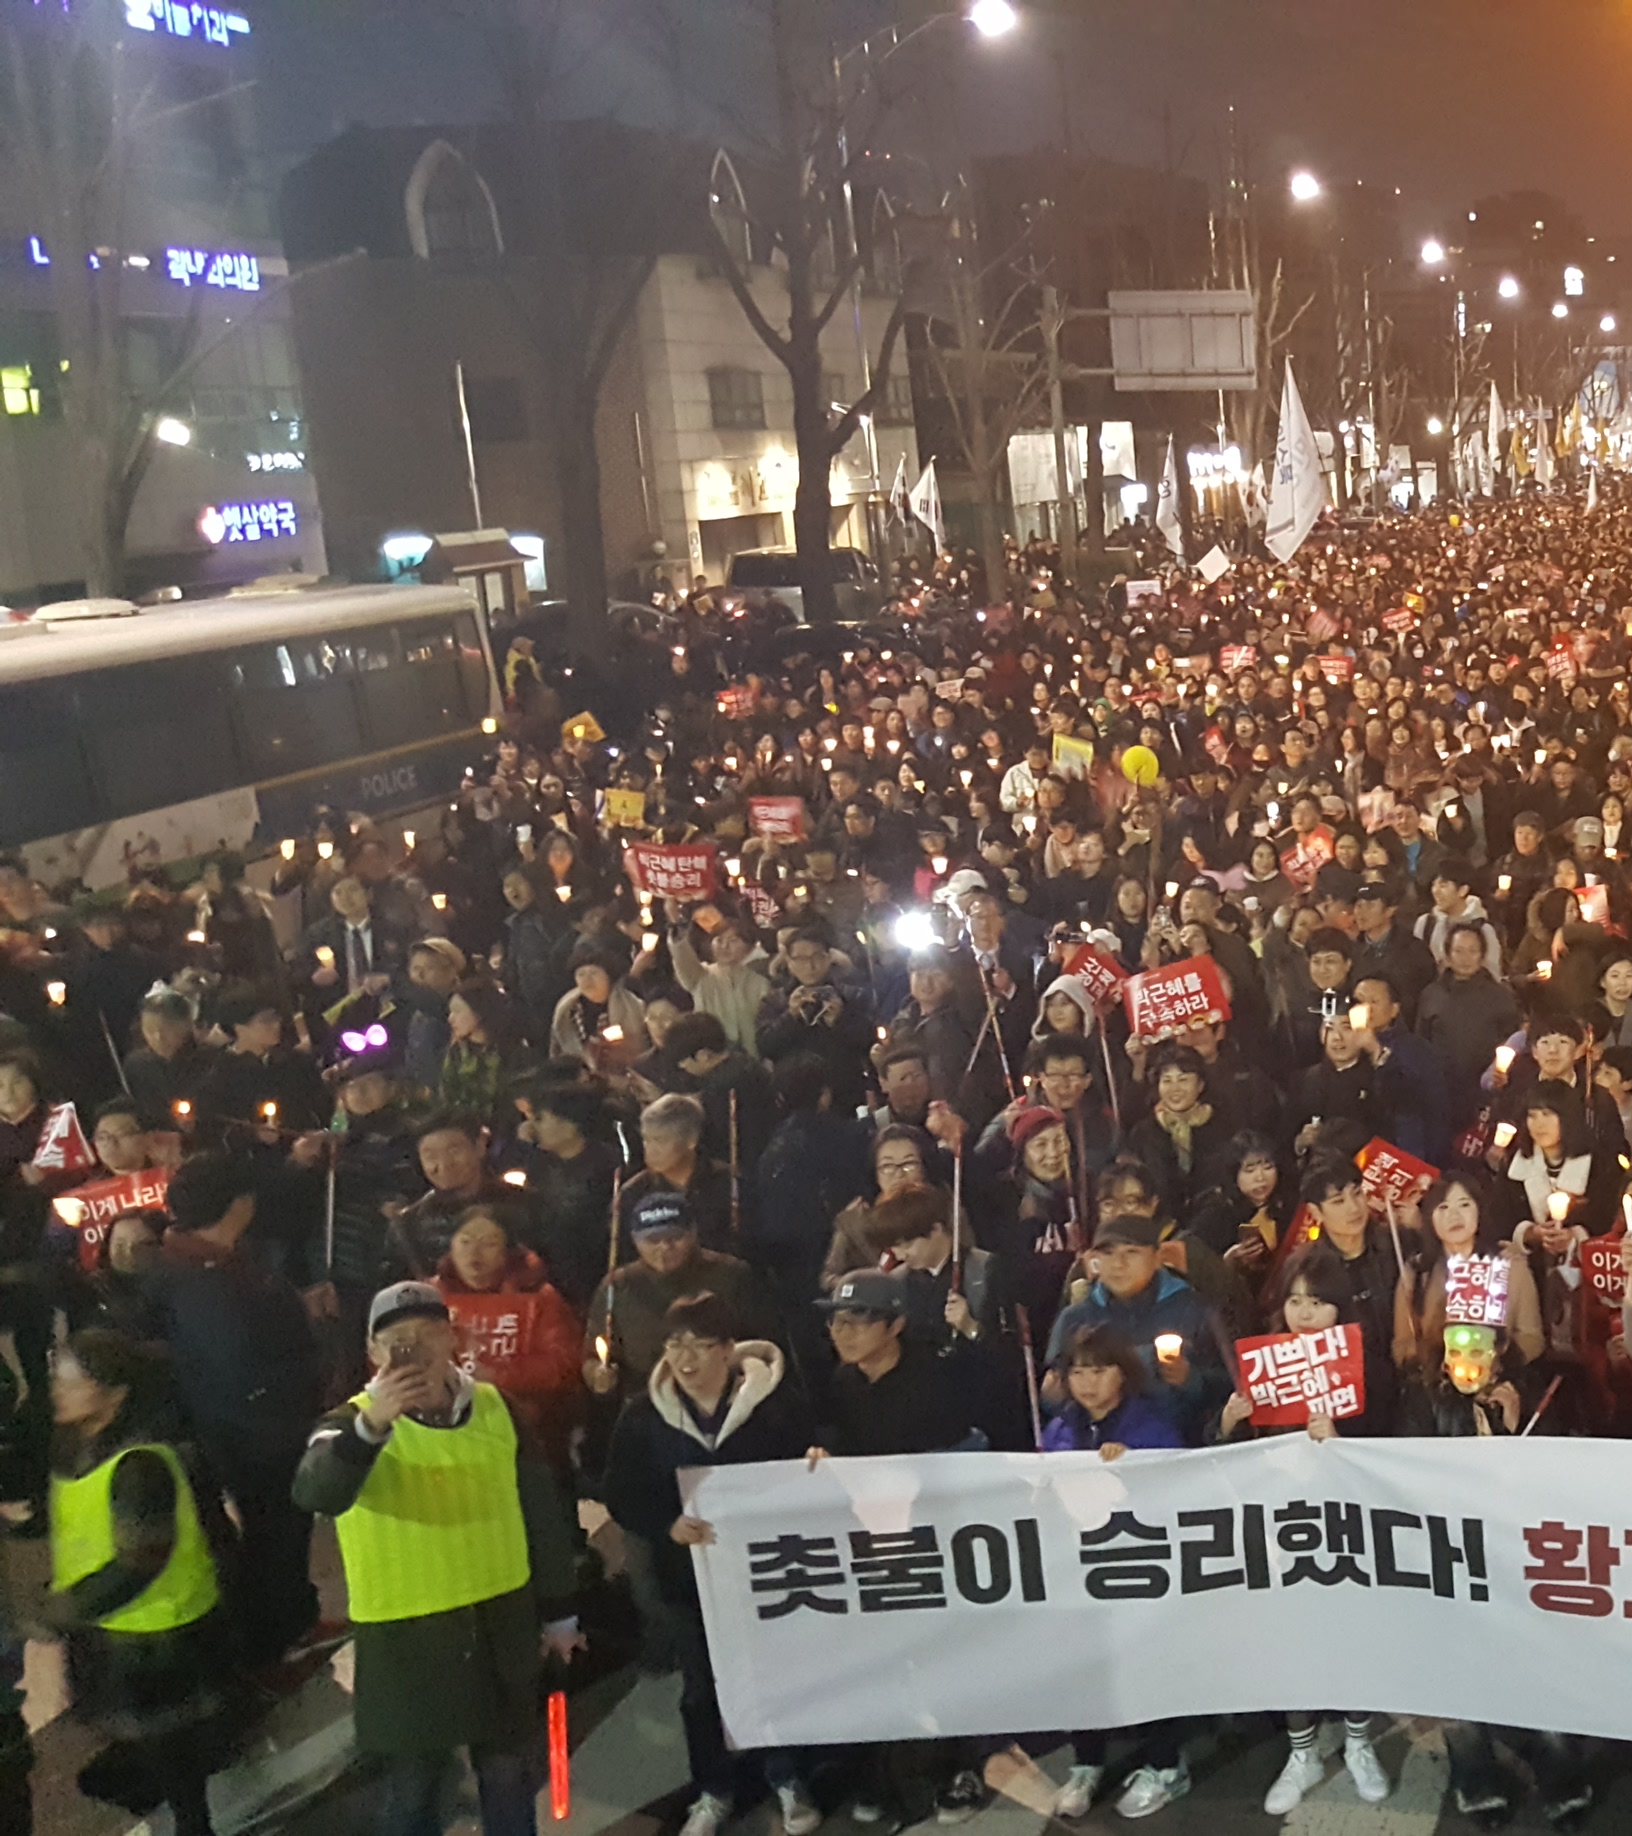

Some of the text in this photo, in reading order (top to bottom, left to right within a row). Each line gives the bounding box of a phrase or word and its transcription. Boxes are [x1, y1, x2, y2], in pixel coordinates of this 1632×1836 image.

[362, 766, 418, 799] POLICE
[1136, 971, 1203, 1007] 박근혜를
[1139, 992, 1210, 1031] 구속하라
[119, 1182, 168, 1210] 나라
[1242, 1325, 1349, 1383] 기쁘다!
[1250, 1365, 1330, 1408] 박근혜
[748, 1518, 1047, 1621] 촛불이
[1079, 1499, 1490, 1603] 승리했다!
